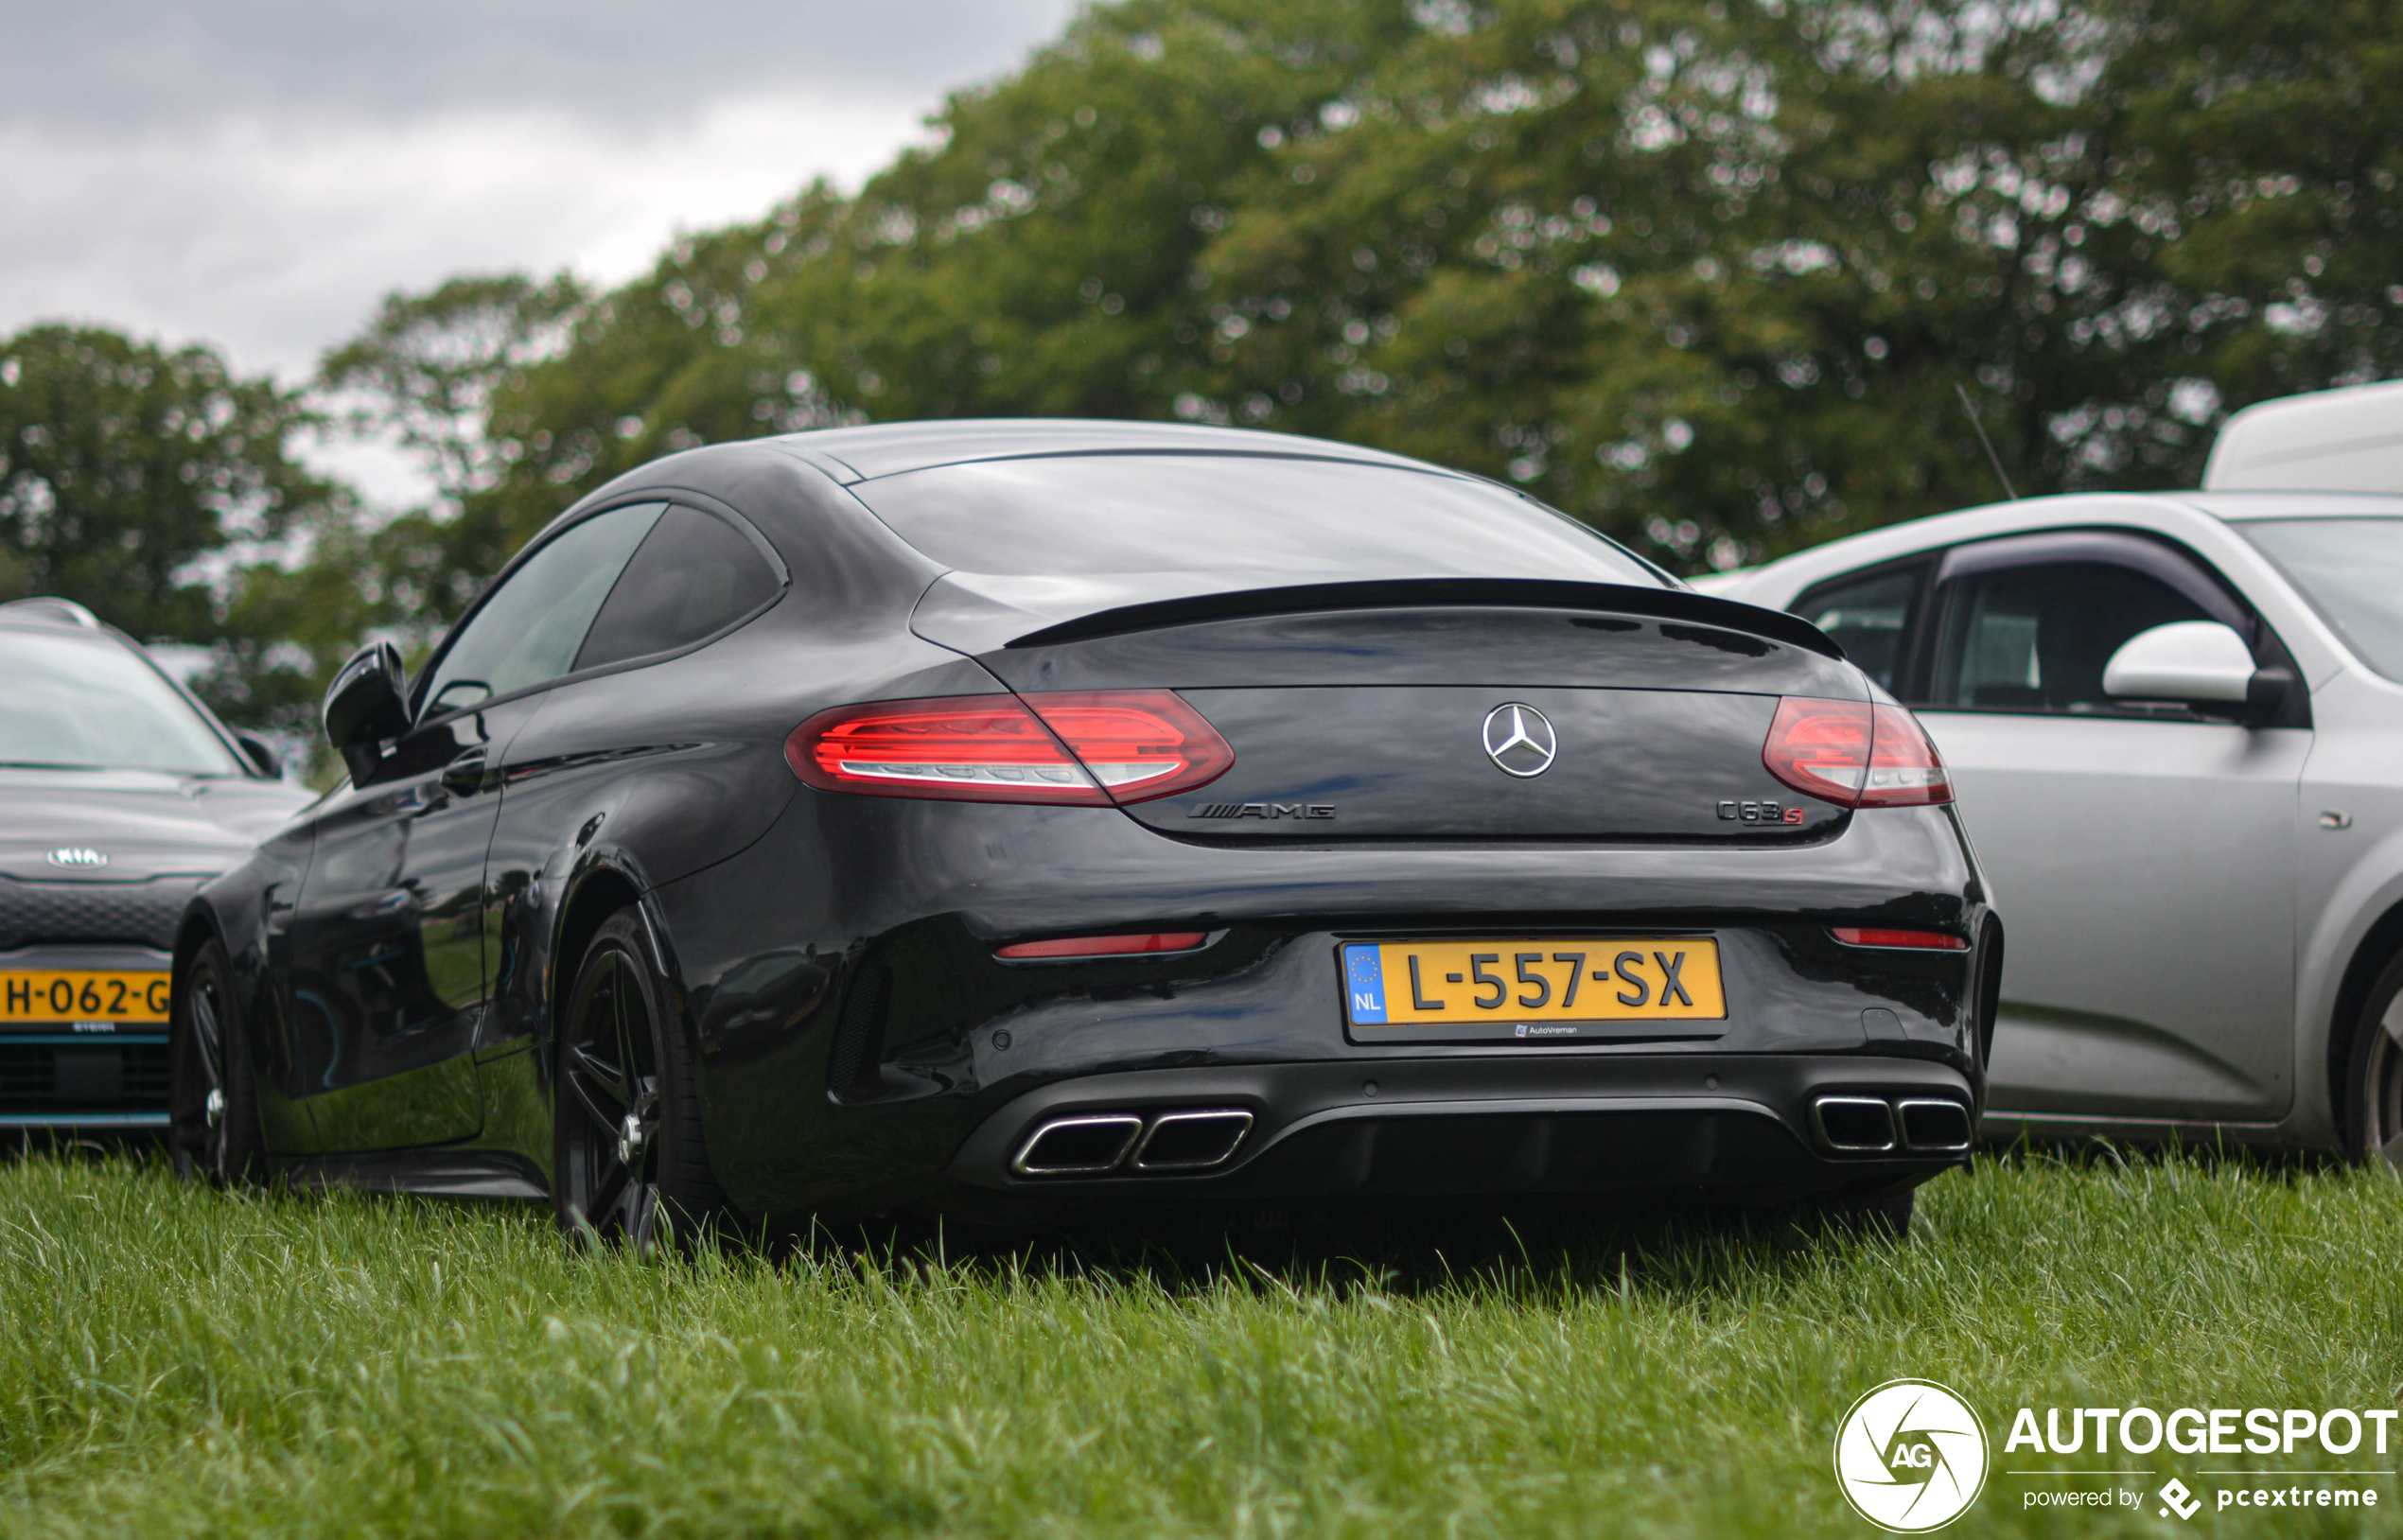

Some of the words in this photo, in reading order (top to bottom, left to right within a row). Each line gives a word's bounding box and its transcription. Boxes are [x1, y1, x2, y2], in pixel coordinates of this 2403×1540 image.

[56, 847, 99, 865] KIA
[1408, 952, 1693, 1011] L-557-SX
[1355, 993, 1381, 1011] NL
[1529, 1026, 1578, 1035] AutoVreman
